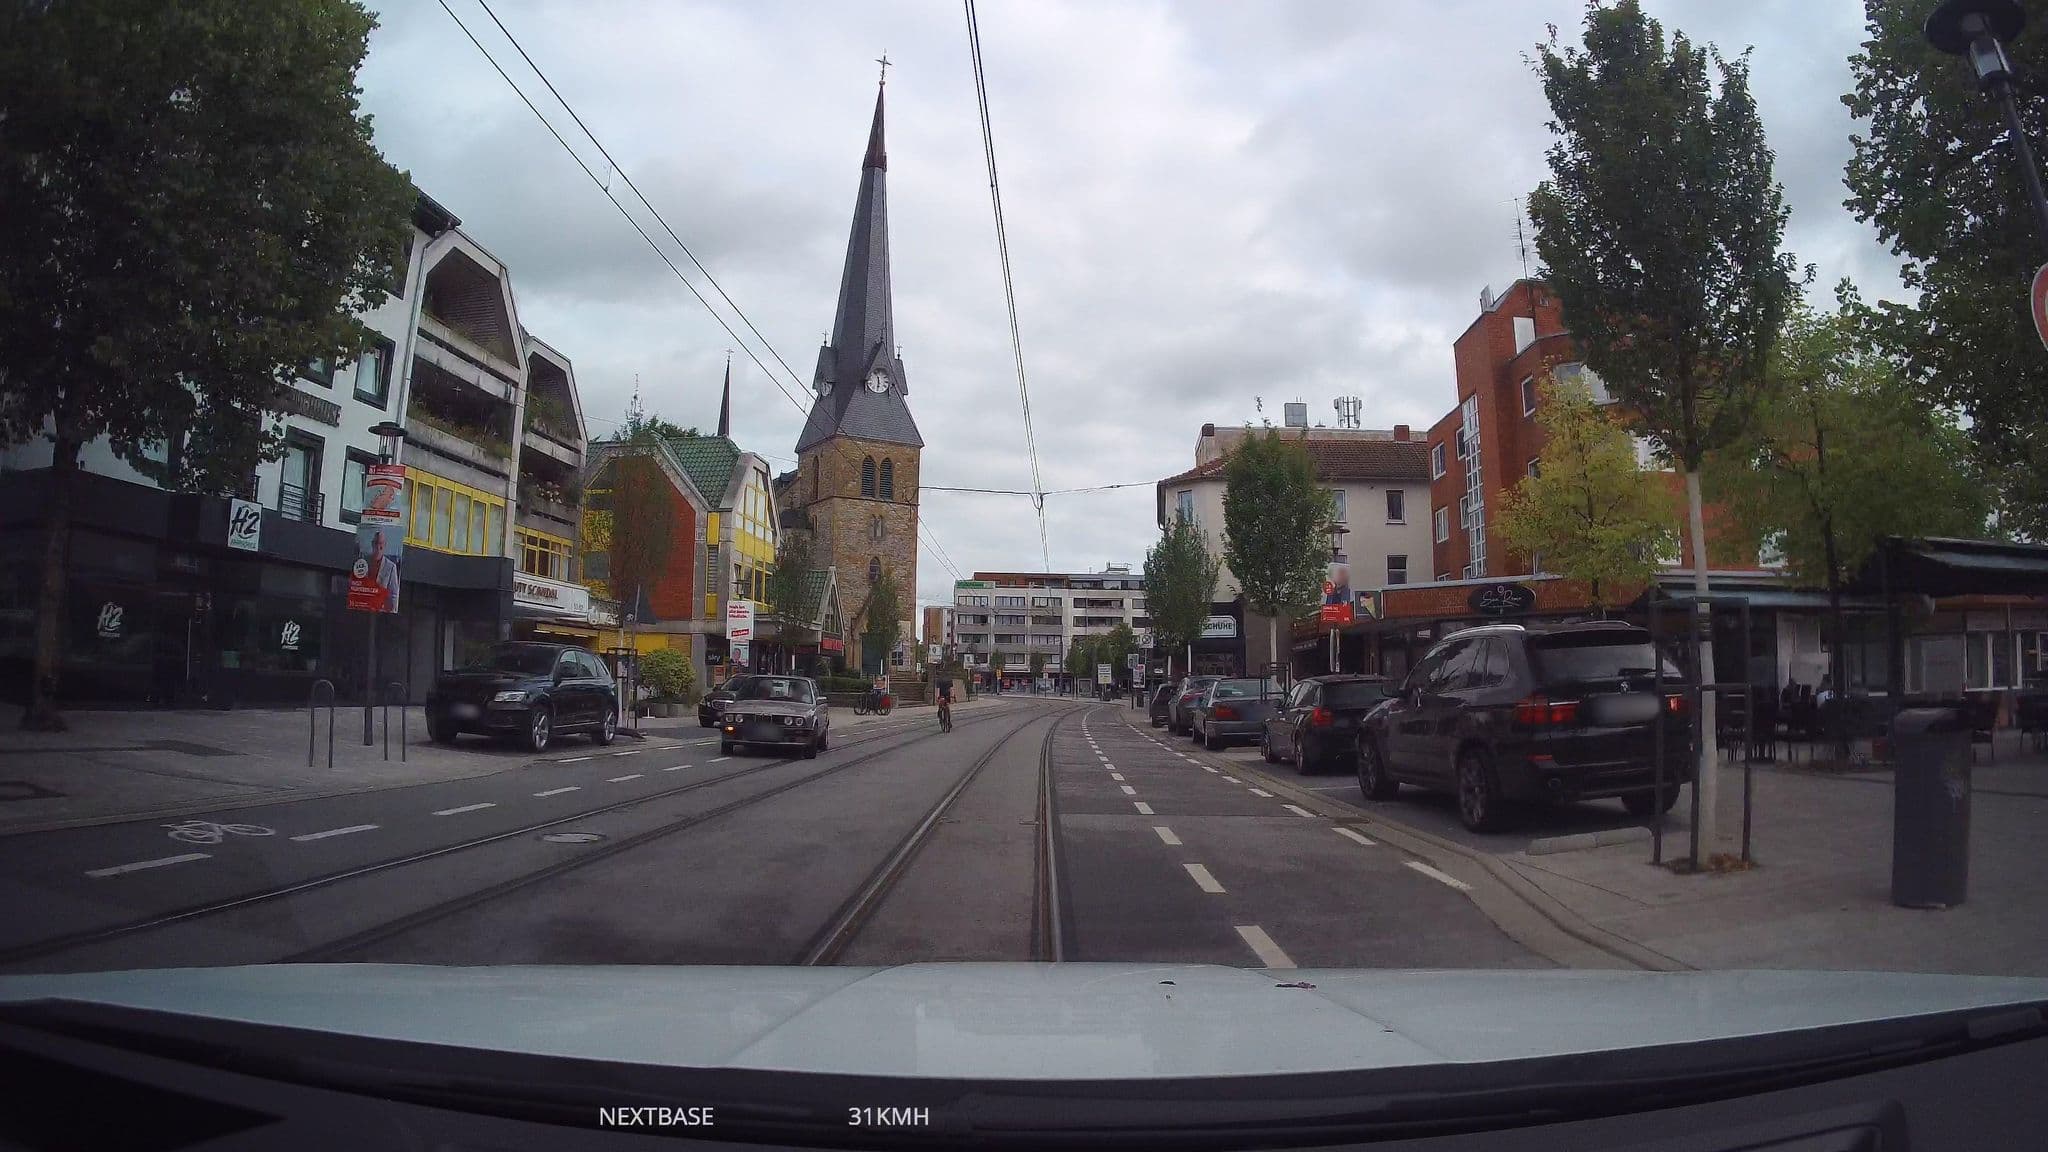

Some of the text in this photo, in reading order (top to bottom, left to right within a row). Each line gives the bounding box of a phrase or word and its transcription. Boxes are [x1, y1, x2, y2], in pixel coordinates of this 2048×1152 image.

[230, 506, 260, 536] H2
[513, 580, 528, 594] UTY
[528, 584, 558, 599] SCANDAL
[97, 602, 122, 630] H2
[281, 621, 300, 644] H2
